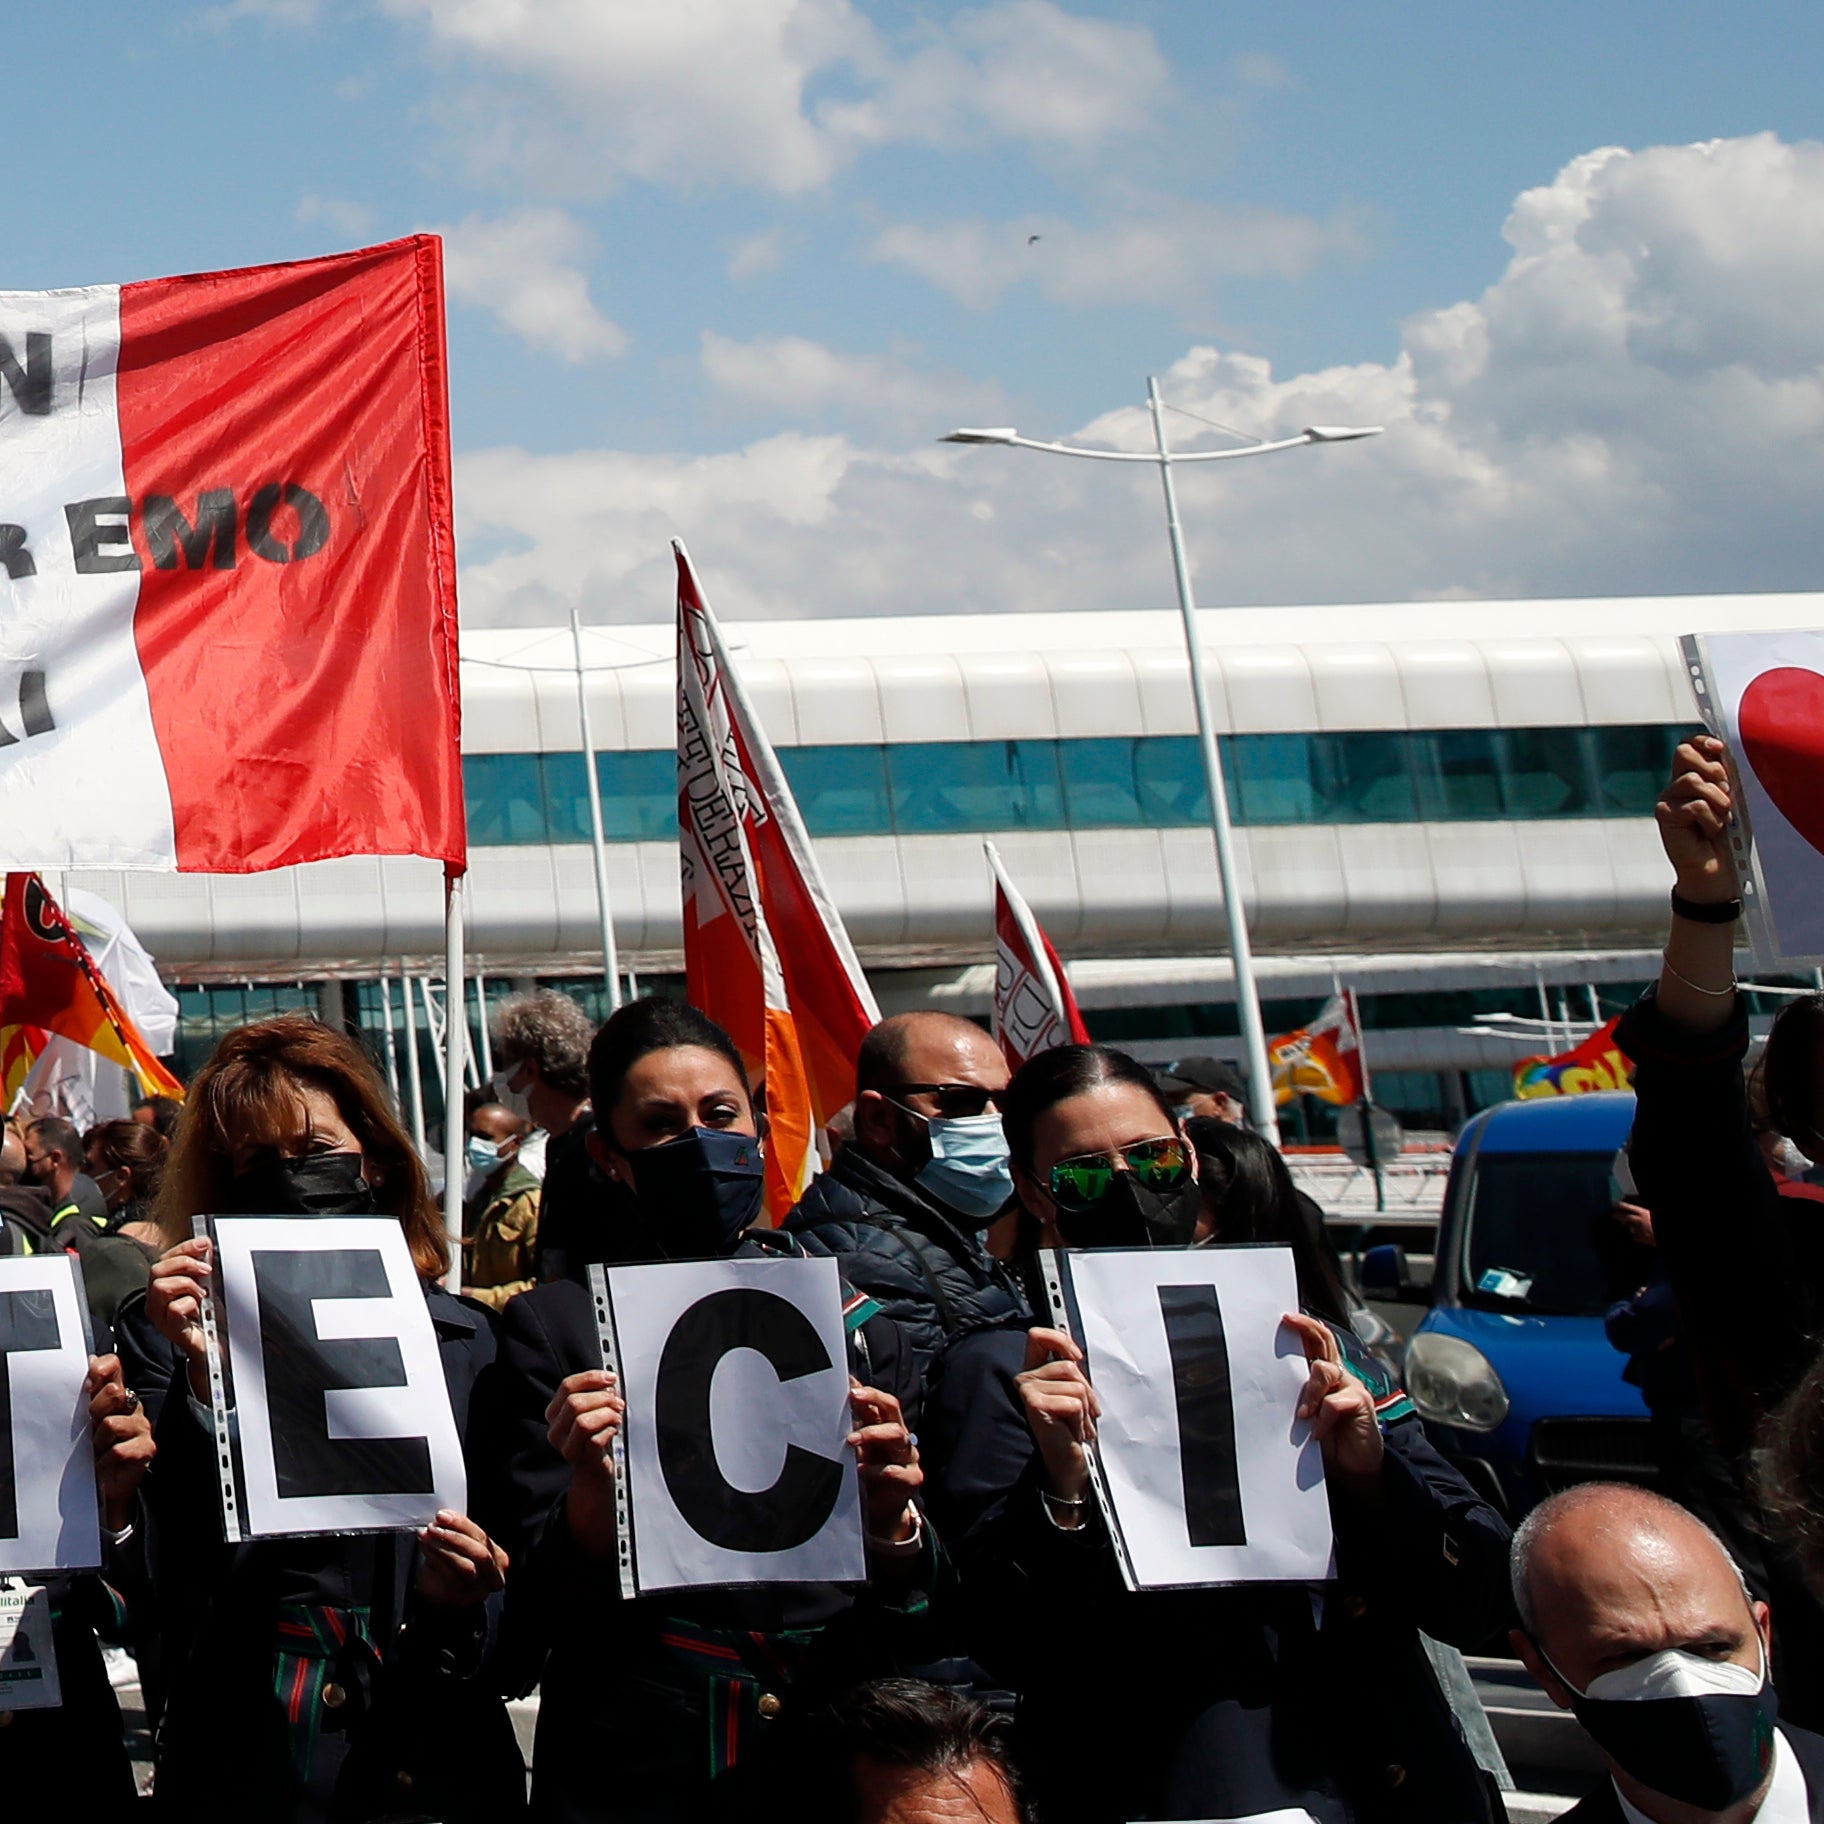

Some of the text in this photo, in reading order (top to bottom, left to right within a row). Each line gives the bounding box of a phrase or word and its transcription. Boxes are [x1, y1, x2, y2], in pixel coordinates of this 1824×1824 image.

[253, 1249, 435, 1498] E
[655, 1288, 844, 1553] C
[1157, 1284, 1248, 1547] I
